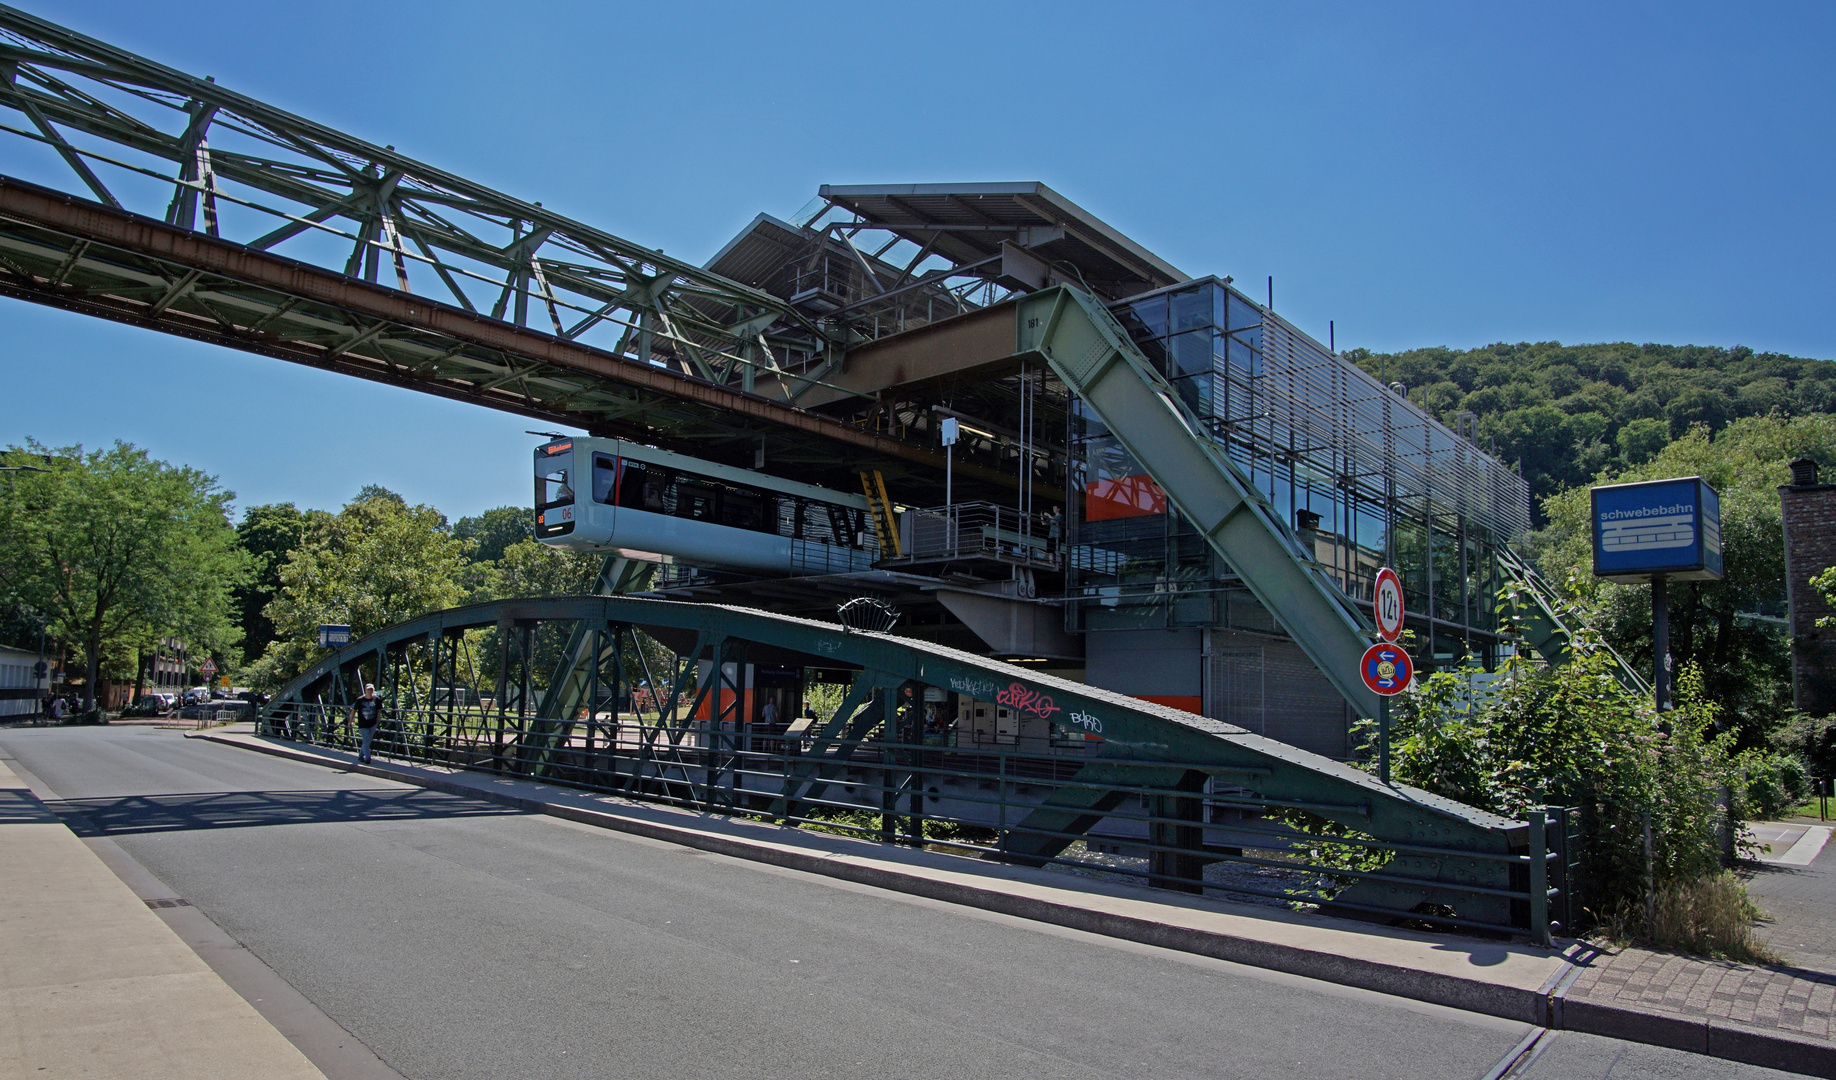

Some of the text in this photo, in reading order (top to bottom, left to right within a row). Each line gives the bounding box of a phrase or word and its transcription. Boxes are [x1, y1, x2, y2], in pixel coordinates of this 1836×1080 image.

[1028, 317, 1038, 329] 181
[562, 507, 572, 520] 06
[1600, 504, 1693, 520] schwebebahn
[1381, 589, 1397, 621] 12t
